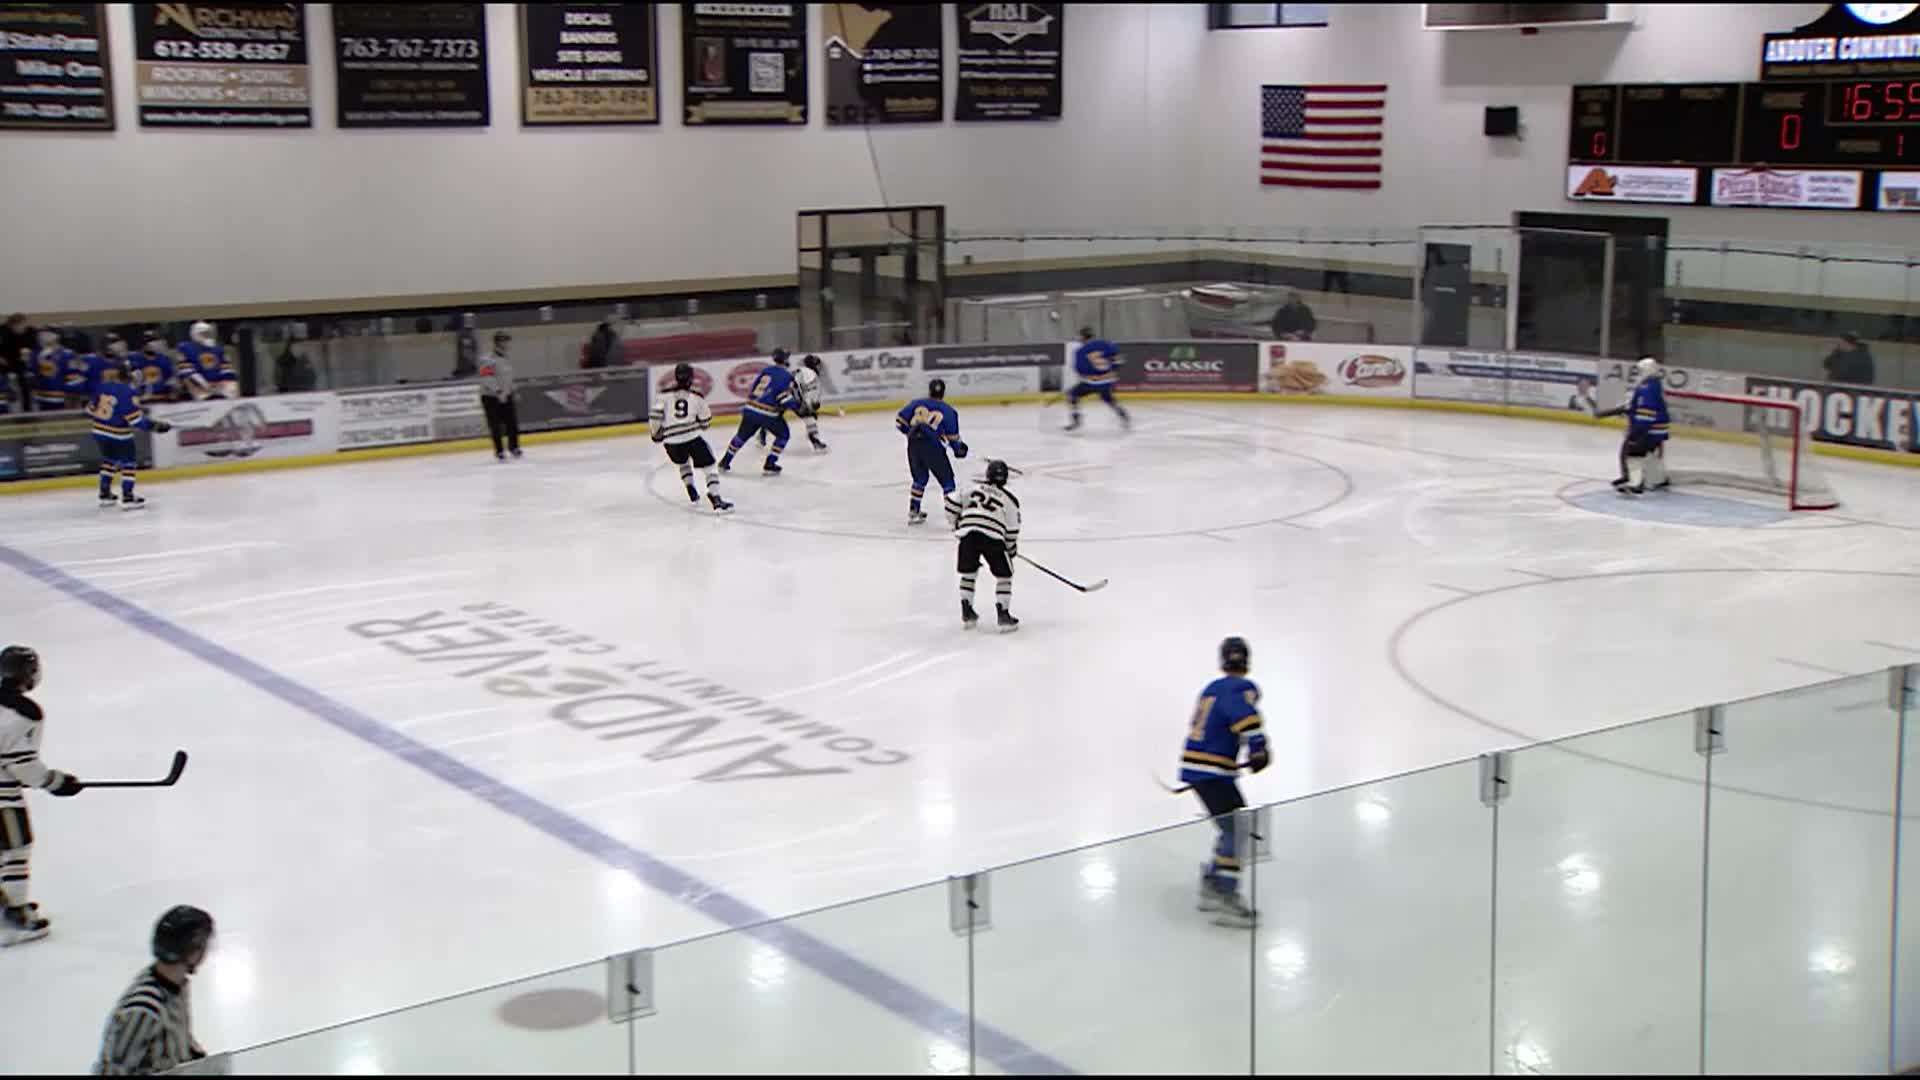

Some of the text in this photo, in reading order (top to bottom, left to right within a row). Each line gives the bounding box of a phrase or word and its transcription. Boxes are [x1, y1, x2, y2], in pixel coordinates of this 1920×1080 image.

[340, 37, 479, 59] 763-767-7373
[560, 31, 618, 44] BANNERS
[557, 50, 623, 63] SITE SIGNS
[1782, 114, 1801, 149] 0
[1593, 131, 1607, 157] 0
[1143, 359, 1225, 372] CLASSIC
[1605, 364, 1689, 388] AEO
[753, 374, 772, 397] 2
[674, 400, 689, 418] 9
